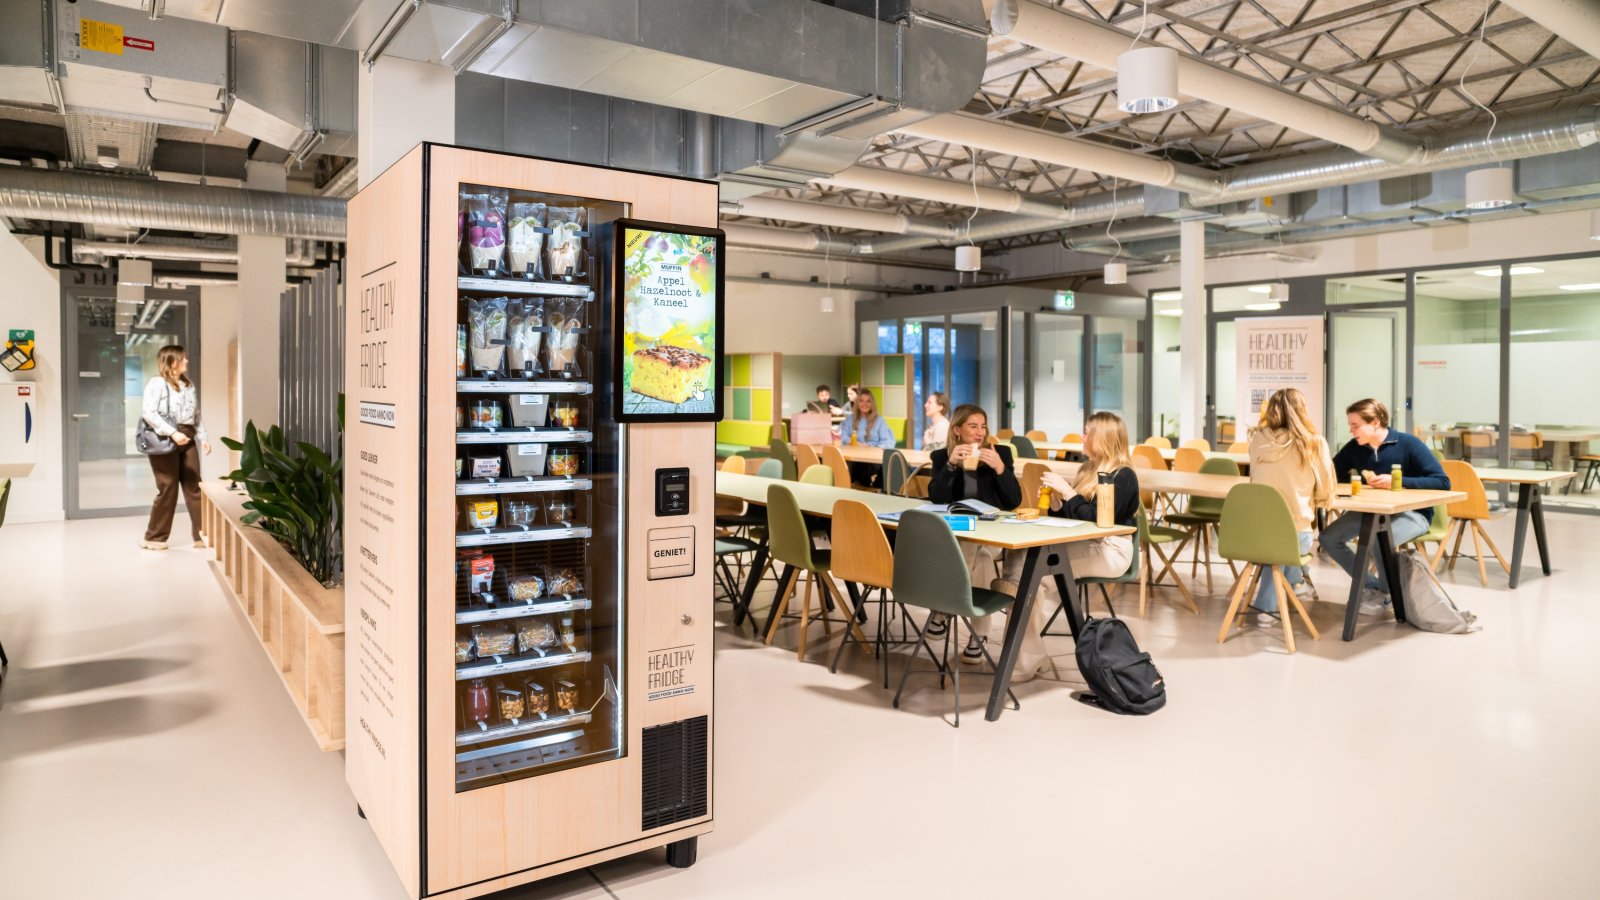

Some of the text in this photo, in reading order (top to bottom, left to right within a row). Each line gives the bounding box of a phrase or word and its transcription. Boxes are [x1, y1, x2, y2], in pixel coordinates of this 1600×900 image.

[627, 232, 643, 248] NIEUW!
[658, 276, 685, 286] Appel
[640, 286, 691, 297] Hazelnoot
[361, 279, 396, 334] HEALTHY
[653, 298, 688, 307] Kaneel
[1249, 333, 1307, 350] HEALTHY
[361, 341, 387, 389] FRIDGE
[1249, 353, 1295, 370] FRIDGE
[654, 548, 686, 557] GENIET!
[648, 649, 694, 671] HEALTHY
[648, 669, 684, 689] FRIDGE
